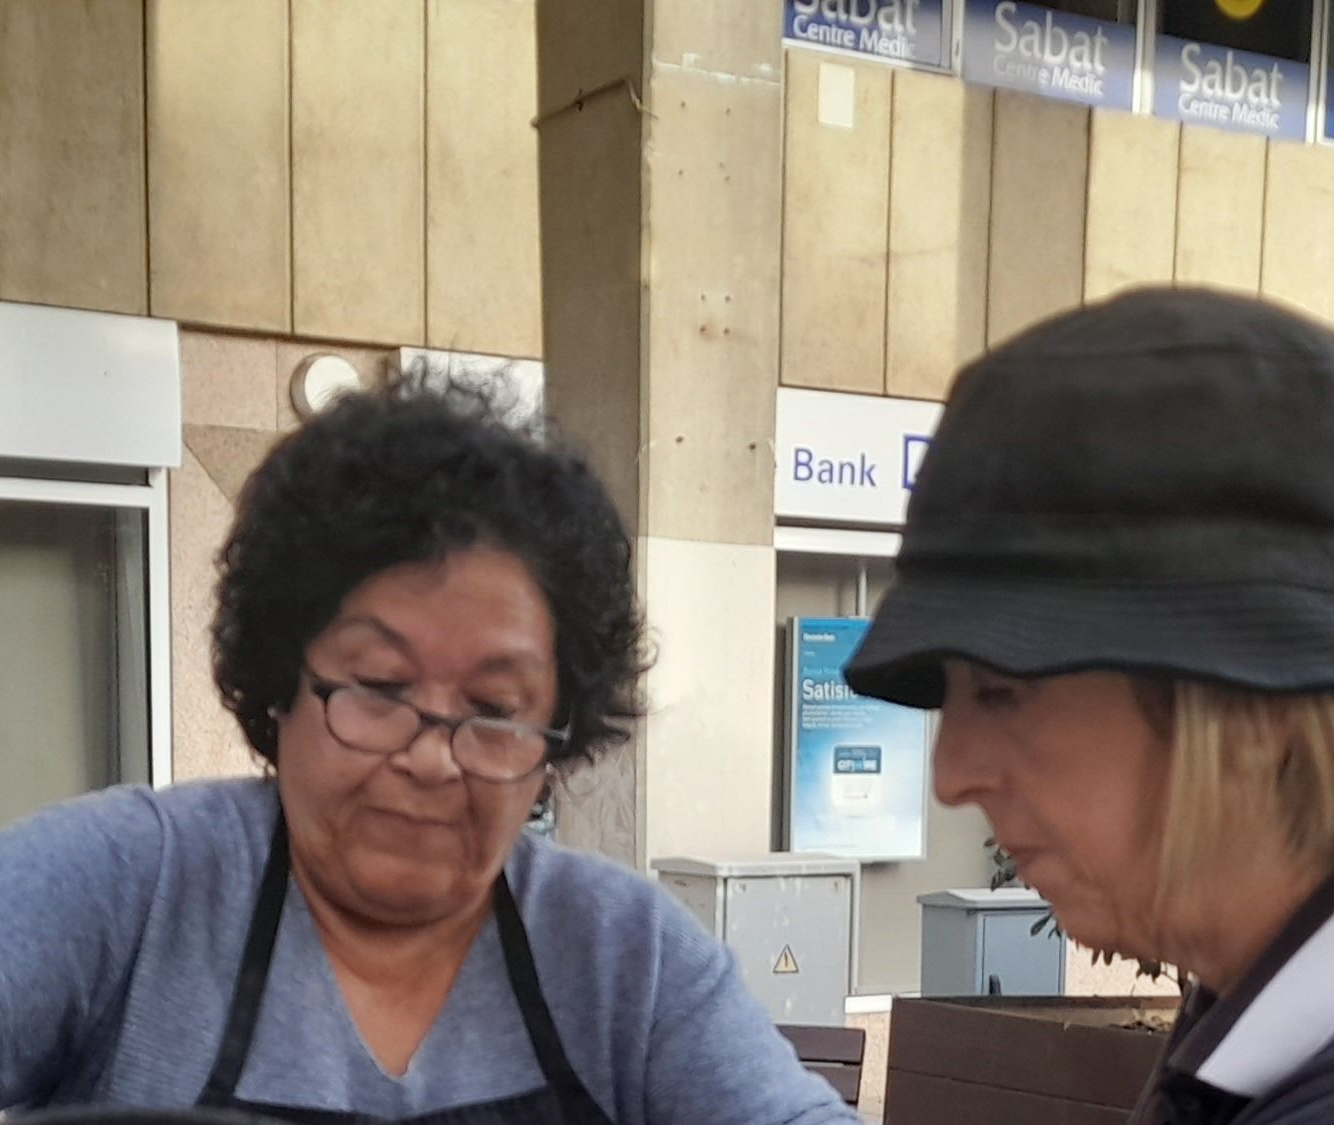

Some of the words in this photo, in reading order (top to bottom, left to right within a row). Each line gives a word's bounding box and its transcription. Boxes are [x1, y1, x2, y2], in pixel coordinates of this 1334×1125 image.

[793, 15, 856, 47] Centre
[994, 1, 1109, 77] Sabat
[992, 54, 1051, 85] Centre
[1179, 42, 1284, 111] Sabat
[1178, 92, 1232, 121] Centre
[793, 446, 877, 488] Bank
